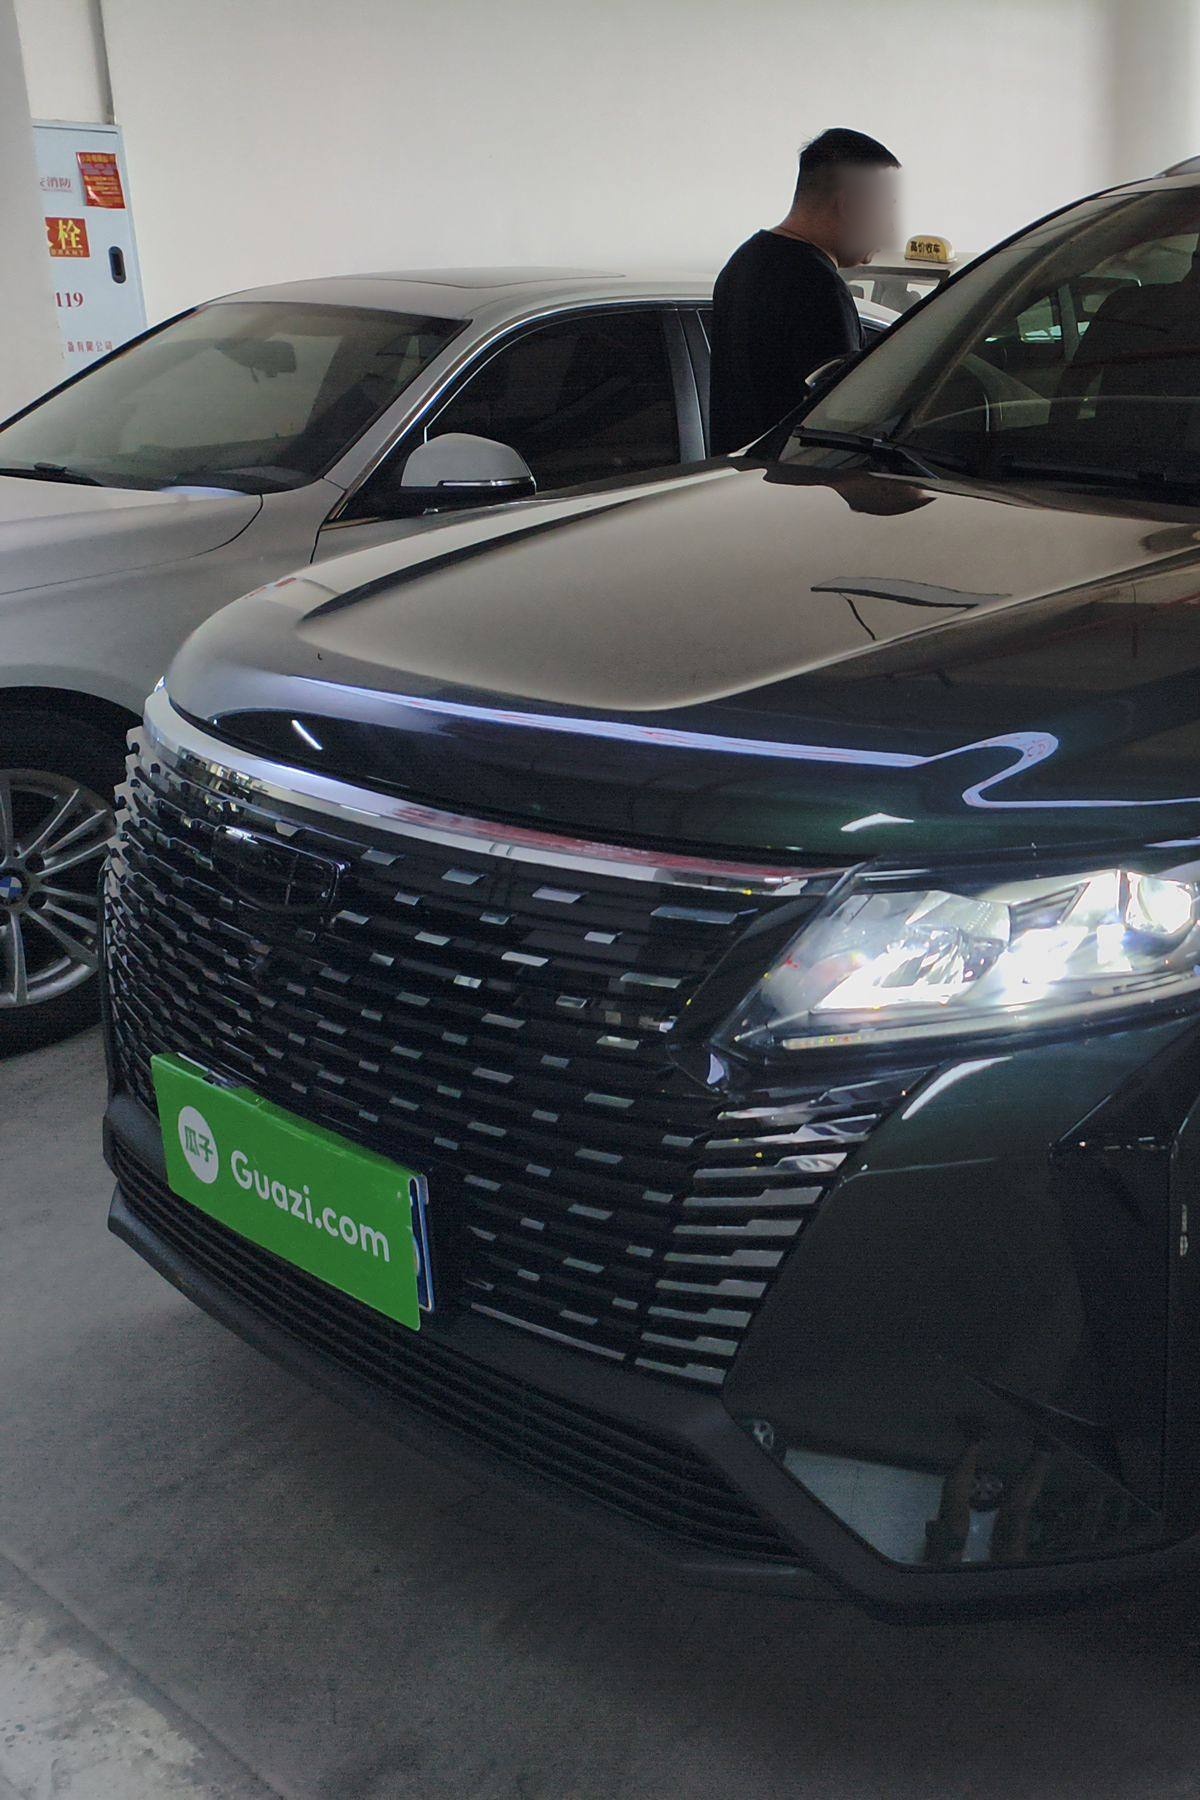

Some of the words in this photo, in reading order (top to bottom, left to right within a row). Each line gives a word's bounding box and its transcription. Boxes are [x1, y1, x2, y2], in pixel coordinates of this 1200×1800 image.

[46, 219, 83, 250] 栓
[55, 292, 84, 308] 119
[184, 1124, 214, 1164] 瓜子
[230, 1149, 391, 1262] Guazi.com
